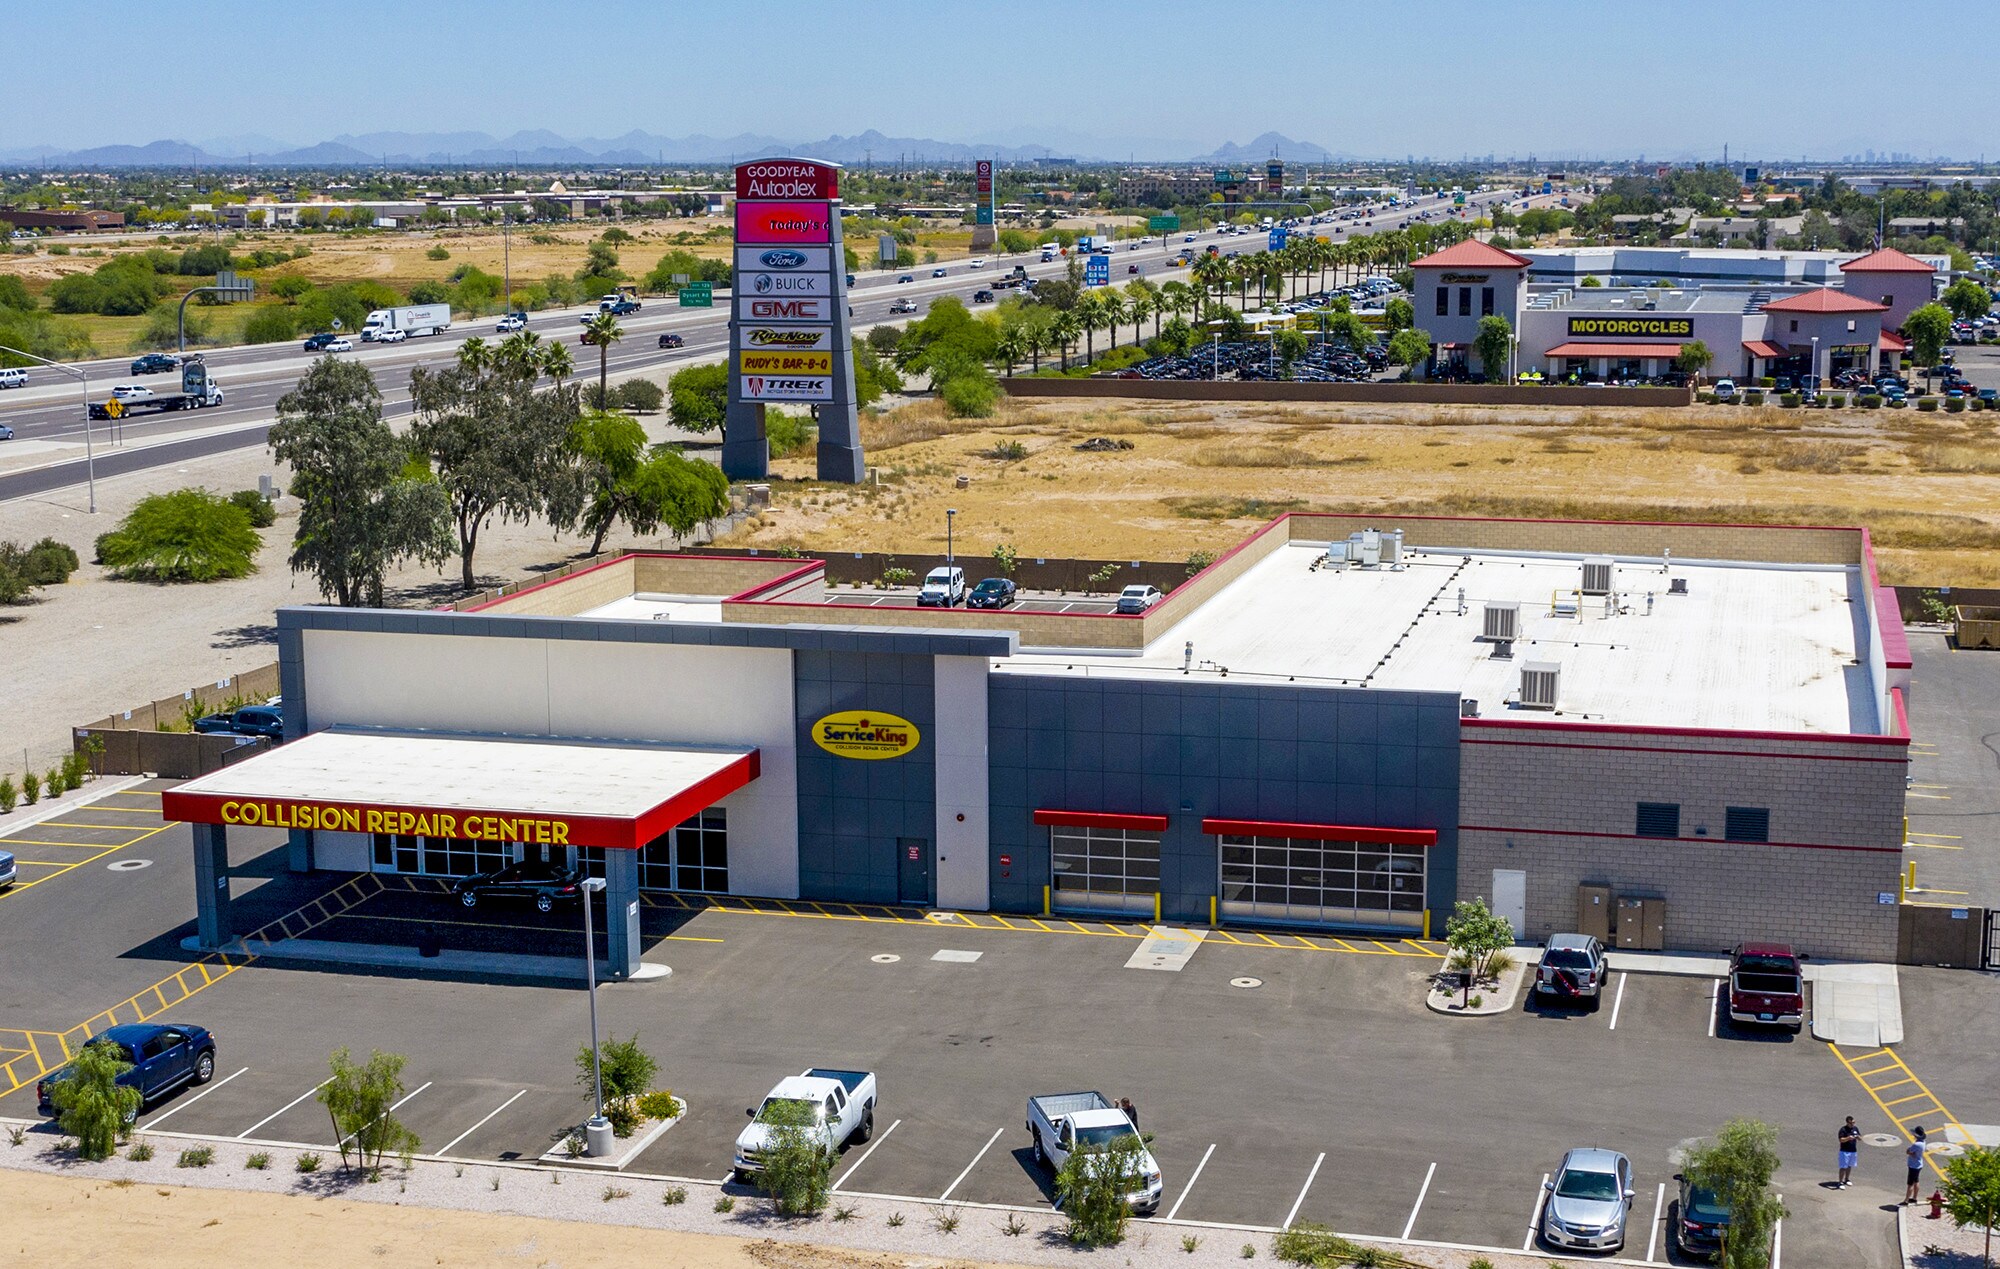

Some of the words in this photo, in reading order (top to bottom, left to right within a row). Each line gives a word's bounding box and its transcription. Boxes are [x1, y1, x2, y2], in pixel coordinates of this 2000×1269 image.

[747, 165, 816, 178] GOODYEAR
[747, 179, 817, 199] Autoplex
[769, 219, 820, 233] Today's
[769, 252, 799, 266] Ford
[776, 277, 816, 291] BUICK
[751, 300, 819, 318] GMC
[1571, 320, 1690, 334] MOTORCYCLES
[744, 356, 780, 370] RUDY'S
[782, 357, 829, 371] BAR-B-Q
[766, 379, 825, 390] TREK
[823, 725, 908, 747] ServiceKing
[880, 745, 900, 753] CENTER
[220, 800, 361, 832] COLLISION
[366, 809, 457, 838] REPAIR
[463, 815, 570, 845] CENTER
